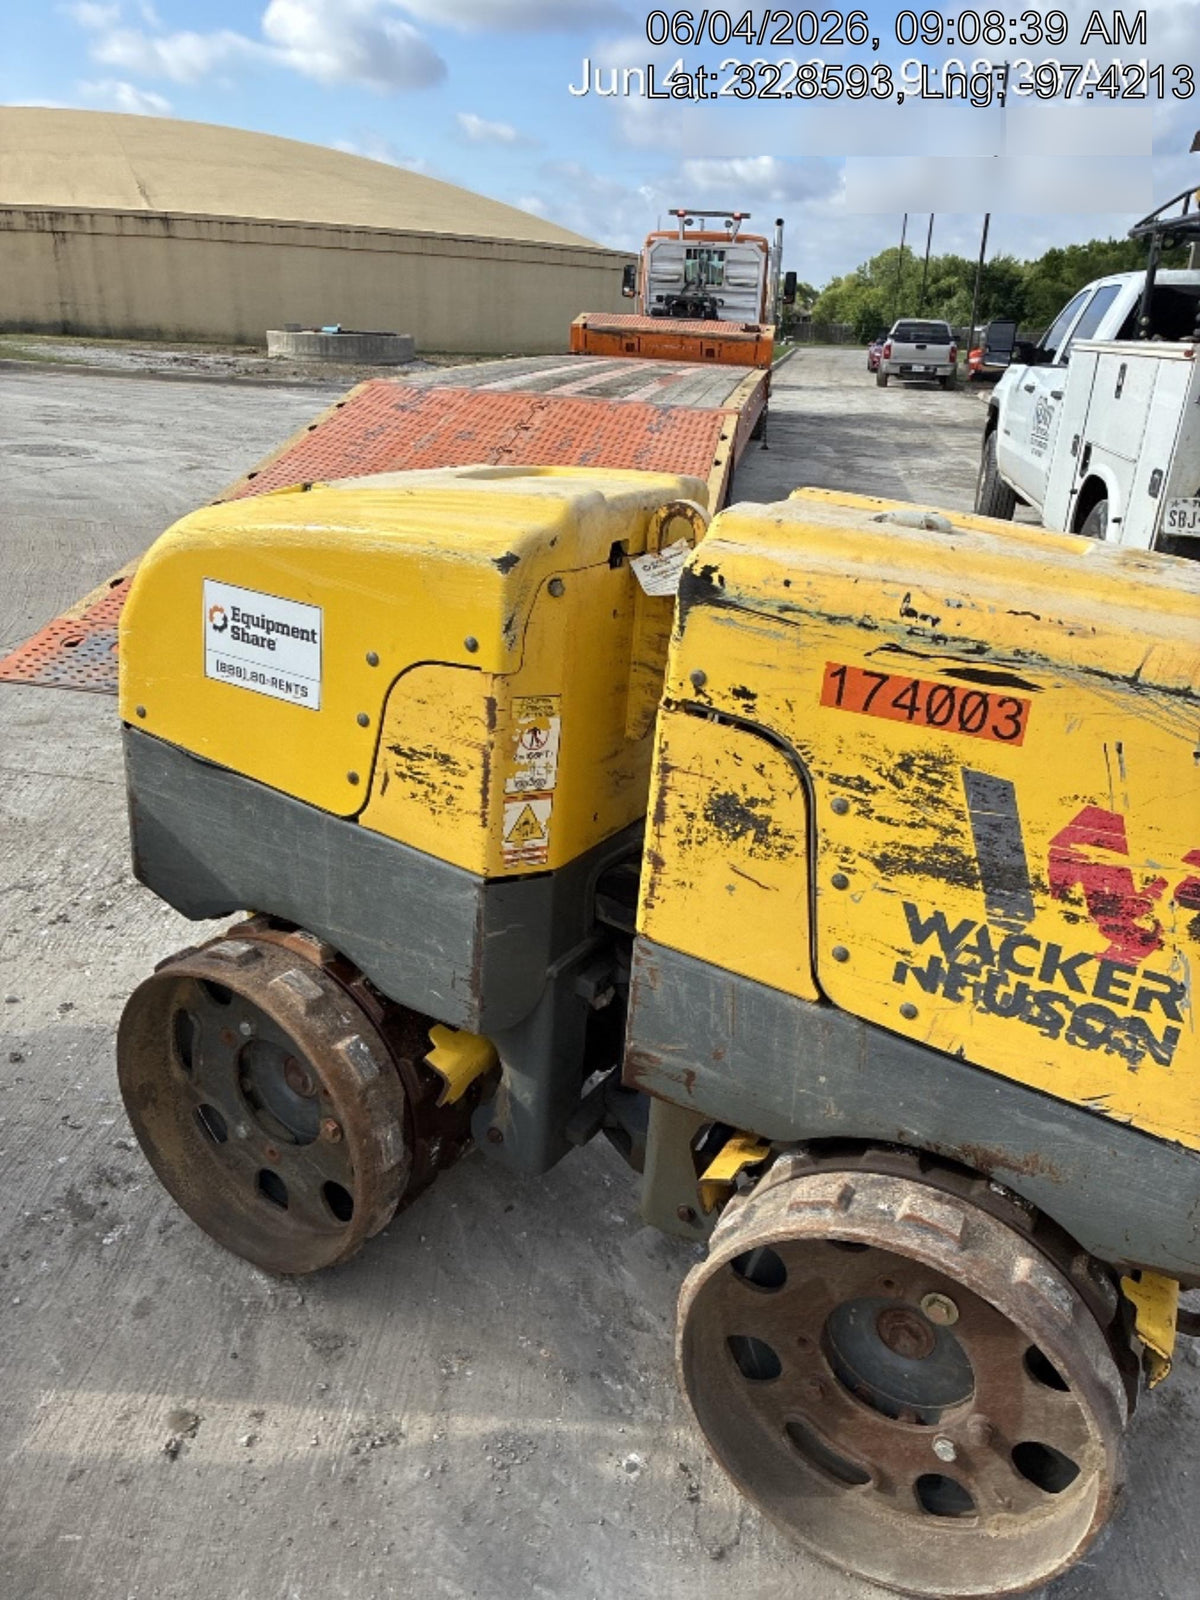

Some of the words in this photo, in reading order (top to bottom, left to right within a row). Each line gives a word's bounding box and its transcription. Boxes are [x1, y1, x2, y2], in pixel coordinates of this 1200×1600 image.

[231, 606, 318, 644] Equipment
[231, 625, 277, 651] Share
[829, 665, 1024, 741] 174003
[902, 901, 1186, 1023] WACKER
[892, 955, 1182, 1070] NEUSON
